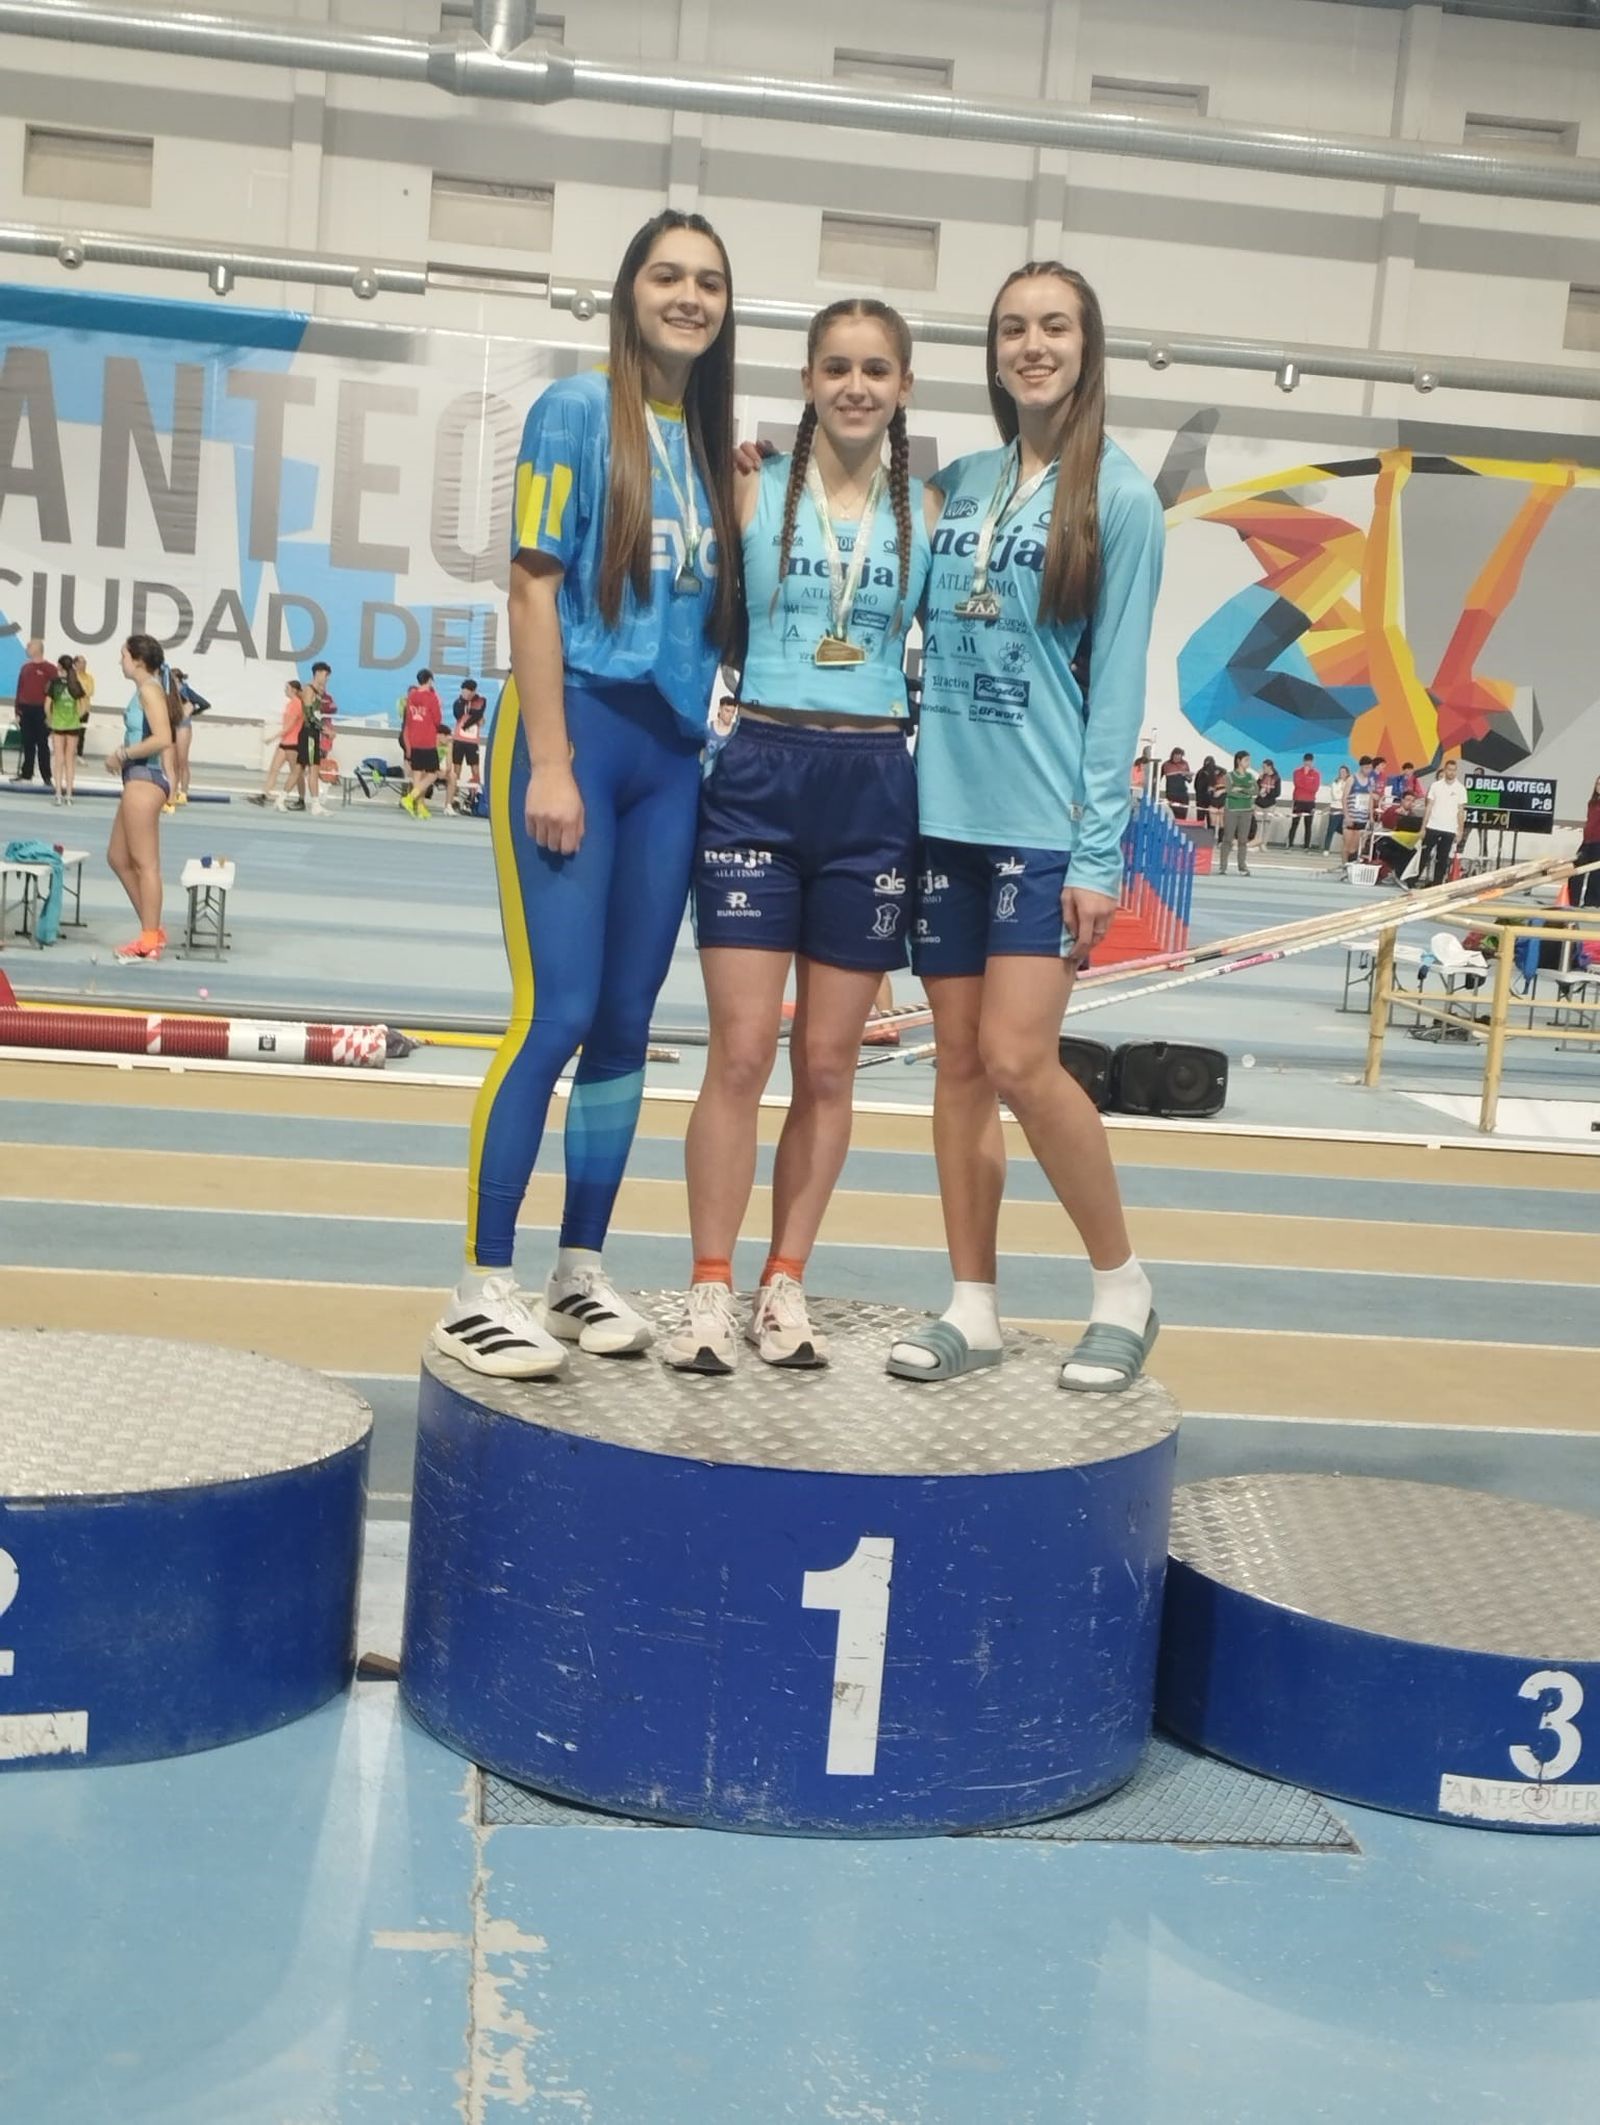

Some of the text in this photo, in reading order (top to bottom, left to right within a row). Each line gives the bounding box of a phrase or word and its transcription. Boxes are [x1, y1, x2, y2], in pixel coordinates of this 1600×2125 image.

[931, 525, 1046, 573] neja
[936, 573, 1018, 599] ATLESMO
[1474, 794, 1489, 804] 27
[1475, 778, 1505, 791] BREA
[1507, 780, 1552, 795] ORTEGA
[1481, 811, 1507, 826] 1.70
[917, 869, 949, 894] rja
[801, 1536, 895, 1775] 1
[1509, 1669, 1584, 1780] 3
